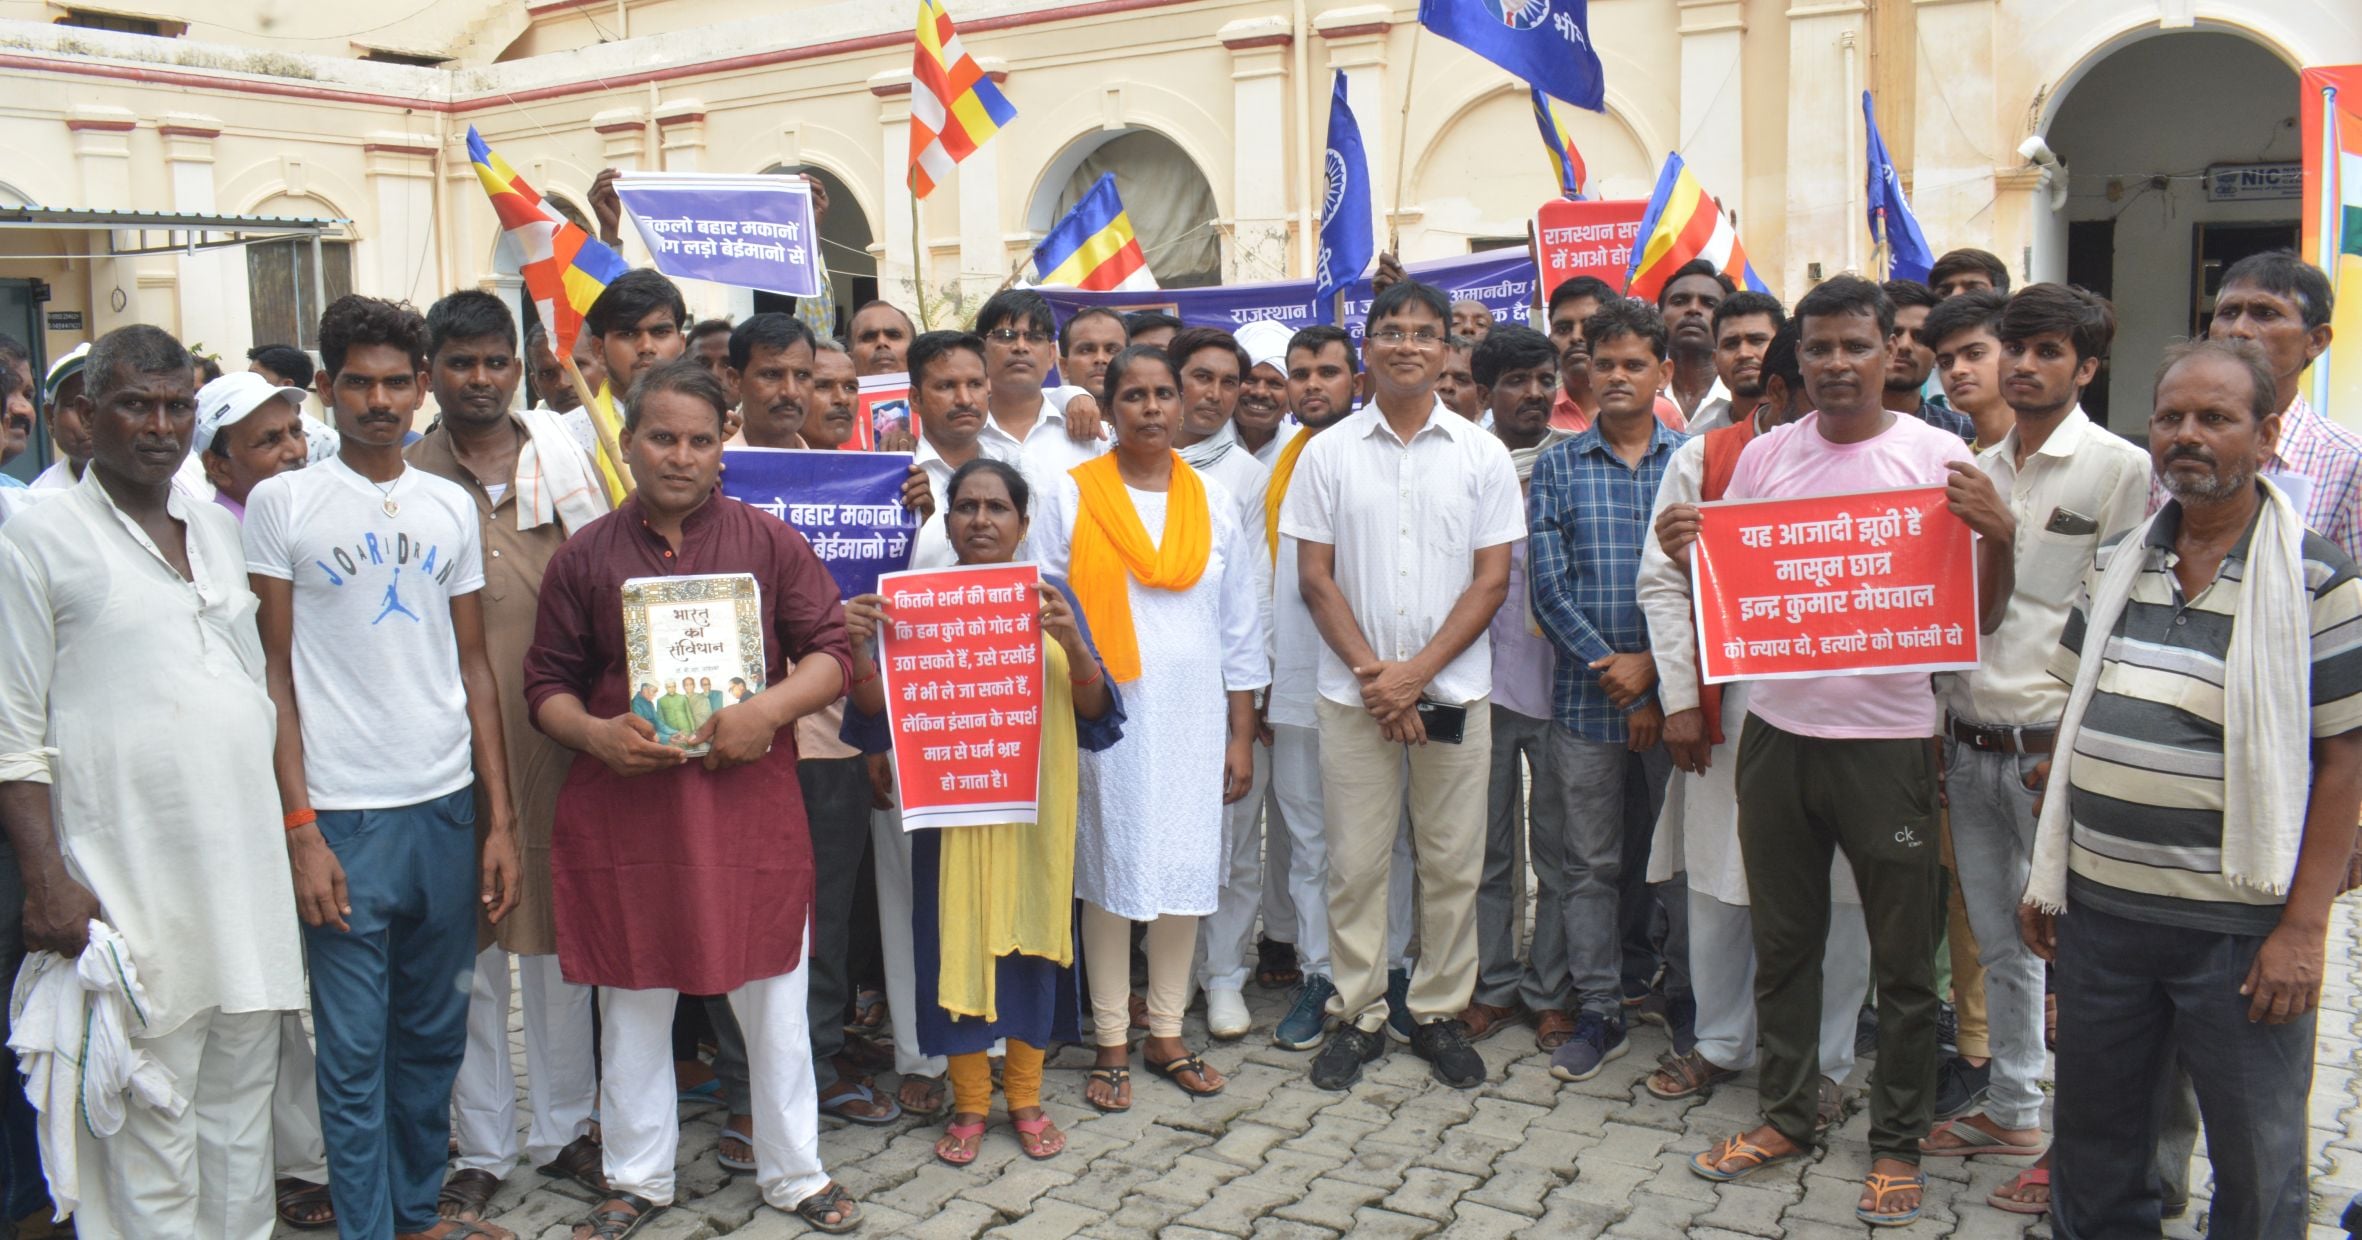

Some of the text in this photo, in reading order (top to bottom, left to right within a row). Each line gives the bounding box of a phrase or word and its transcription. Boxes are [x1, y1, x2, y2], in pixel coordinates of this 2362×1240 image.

[2241, 169, 2280, 185] NIC
[696, 220, 737, 235] बहार
[740, 221, 799, 241] मकानों
[1543, 224, 1615, 245] राजस्थान
[682, 238, 717, 258] लड़ो
[720, 238, 785, 262] बेईमानो
[787, 248, 805, 265] से
[1551, 249, 1568, 269] में
[1570, 246, 1608, 268] आओ
[1230, 304, 1307, 324] राजस्थान
[789, 503, 837, 526] बहार
[1739, 507, 1923, 548] यह आजादी झूठी है
[812, 532, 886, 561] बेईमानो
[888, 532, 908, 558] से
[1774, 552, 1892, 587] मासूम छात्र
[894, 582, 1025, 609] कितने शर्म की बात है
[1739, 582, 1935, 624] इन्द्र कुमार मेघवाल
[673, 608, 710, 626] भारत
[895, 613, 1031, 642] कि हम कुत्ते को गोद में
[669, 639, 724, 662] संविधान
[1723, 623, 1963, 659] को न्याय दो, हत्यारे को फांसी दो
[893, 656, 916, 671] उठा
[918, 650, 955, 670] सकते
[974, 647, 996, 666] उसे
[999, 643, 1036, 665] रसोई
[902, 683, 918, 702] में
[920, 681, 938, 701] भी
[940, 680, 956, 699] ले
[957, 684, 975, 698] जा
[977, 678, 1014, 696] सकते
[901, 706, 1038, 732] लेकिन इंसान के स्पर्श
[922, 746, 951, 762] मात्र
[953, 740, 968, 759] से
[970, 739, 994, 758] धर्म
[940, 772, 955, 791] हो
[957, 774, 988, 790] जाता
